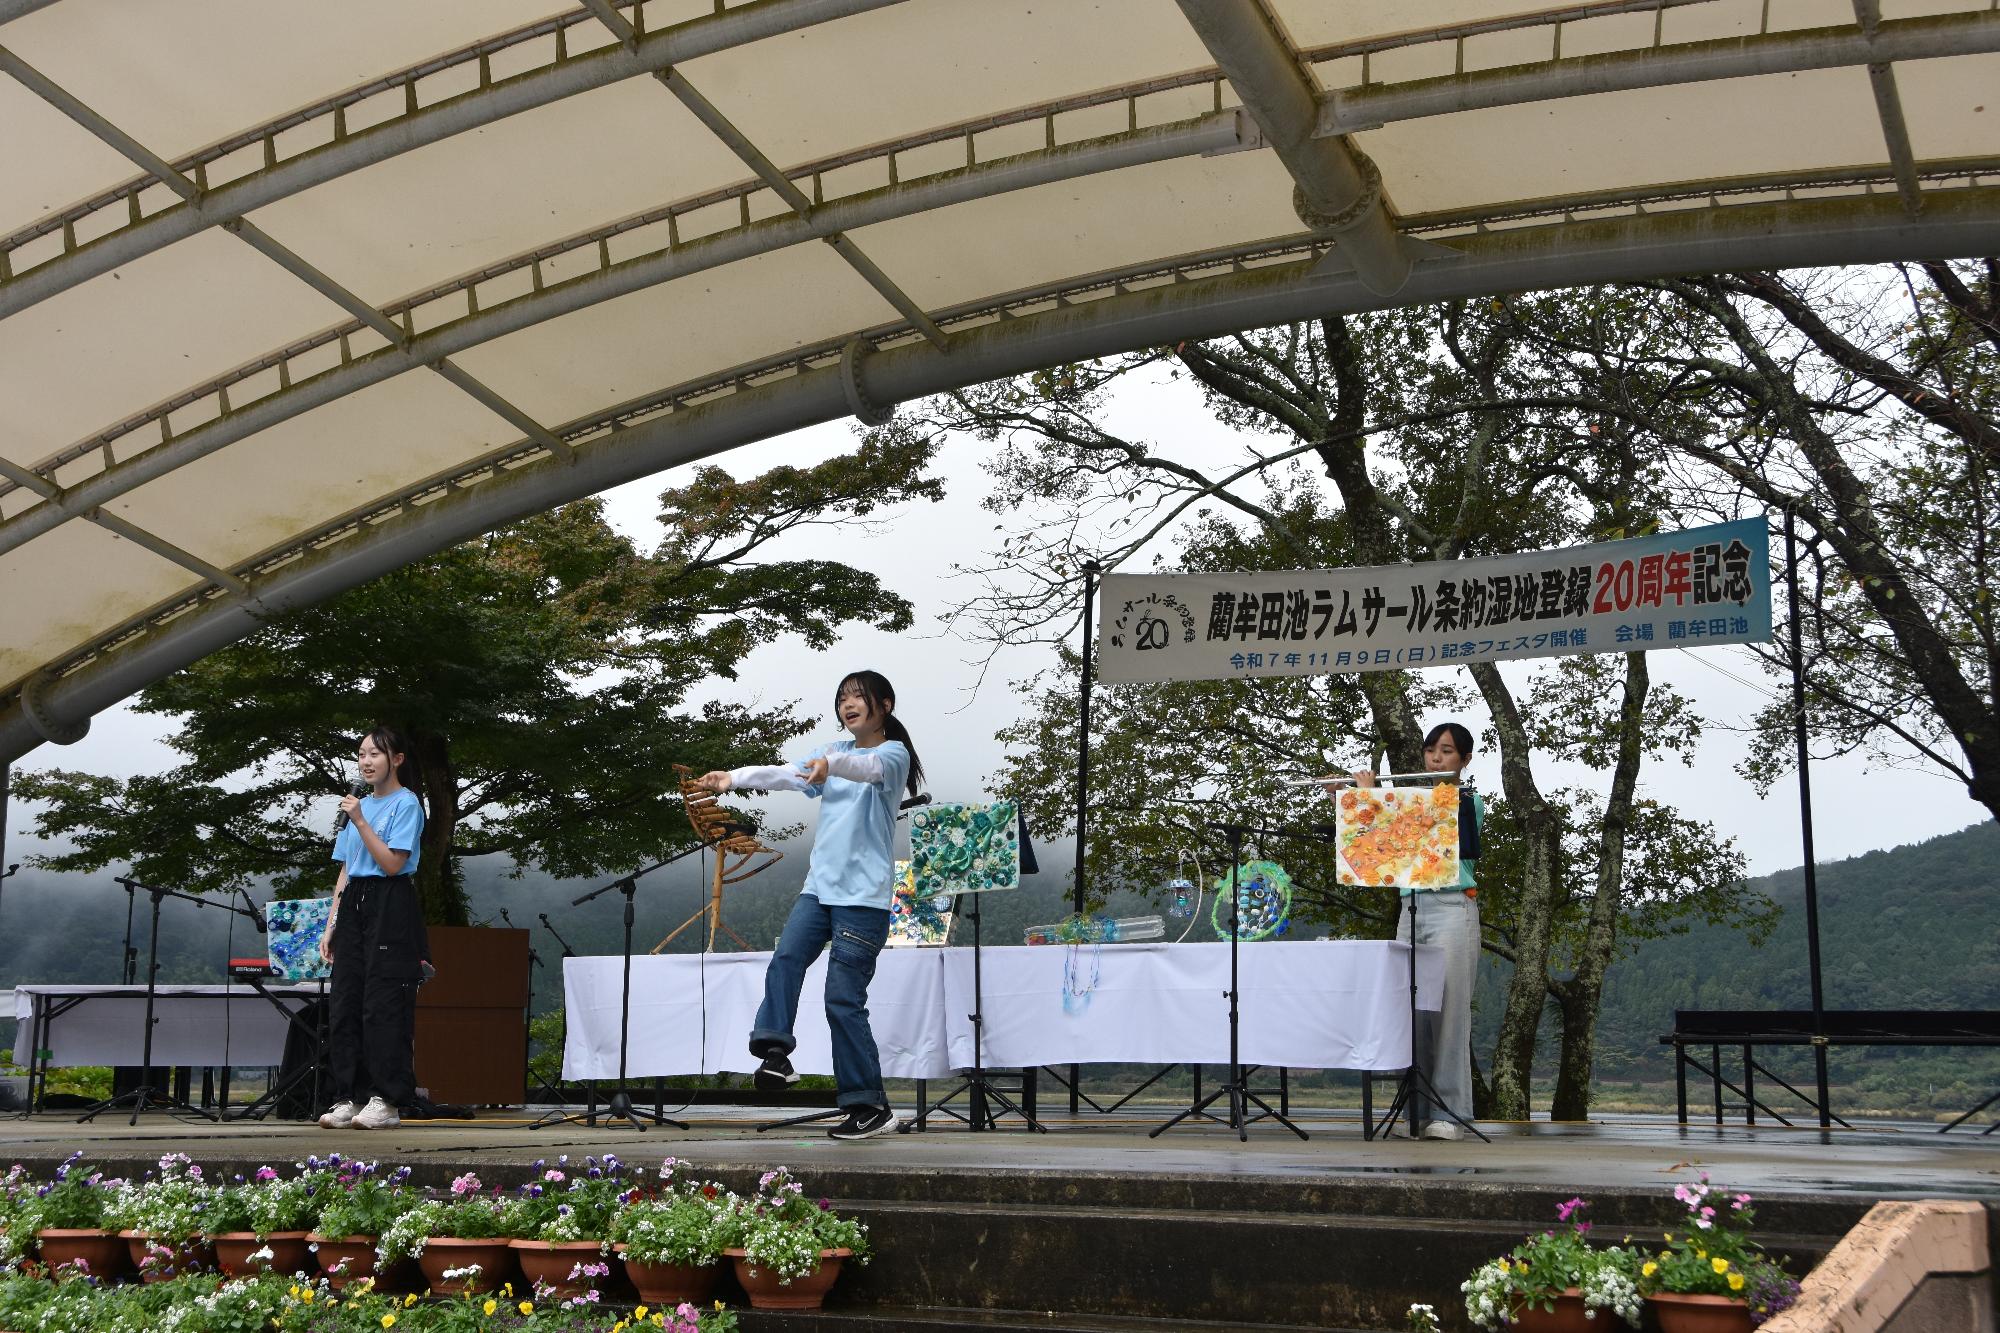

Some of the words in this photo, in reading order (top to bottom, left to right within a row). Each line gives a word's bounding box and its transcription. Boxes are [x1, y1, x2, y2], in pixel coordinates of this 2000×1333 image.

[1135, 618, 1169, 650] 20
[1615, 623, 1654, 643] 会場
[1668, 616, 1749, 640] 藺牟田池
